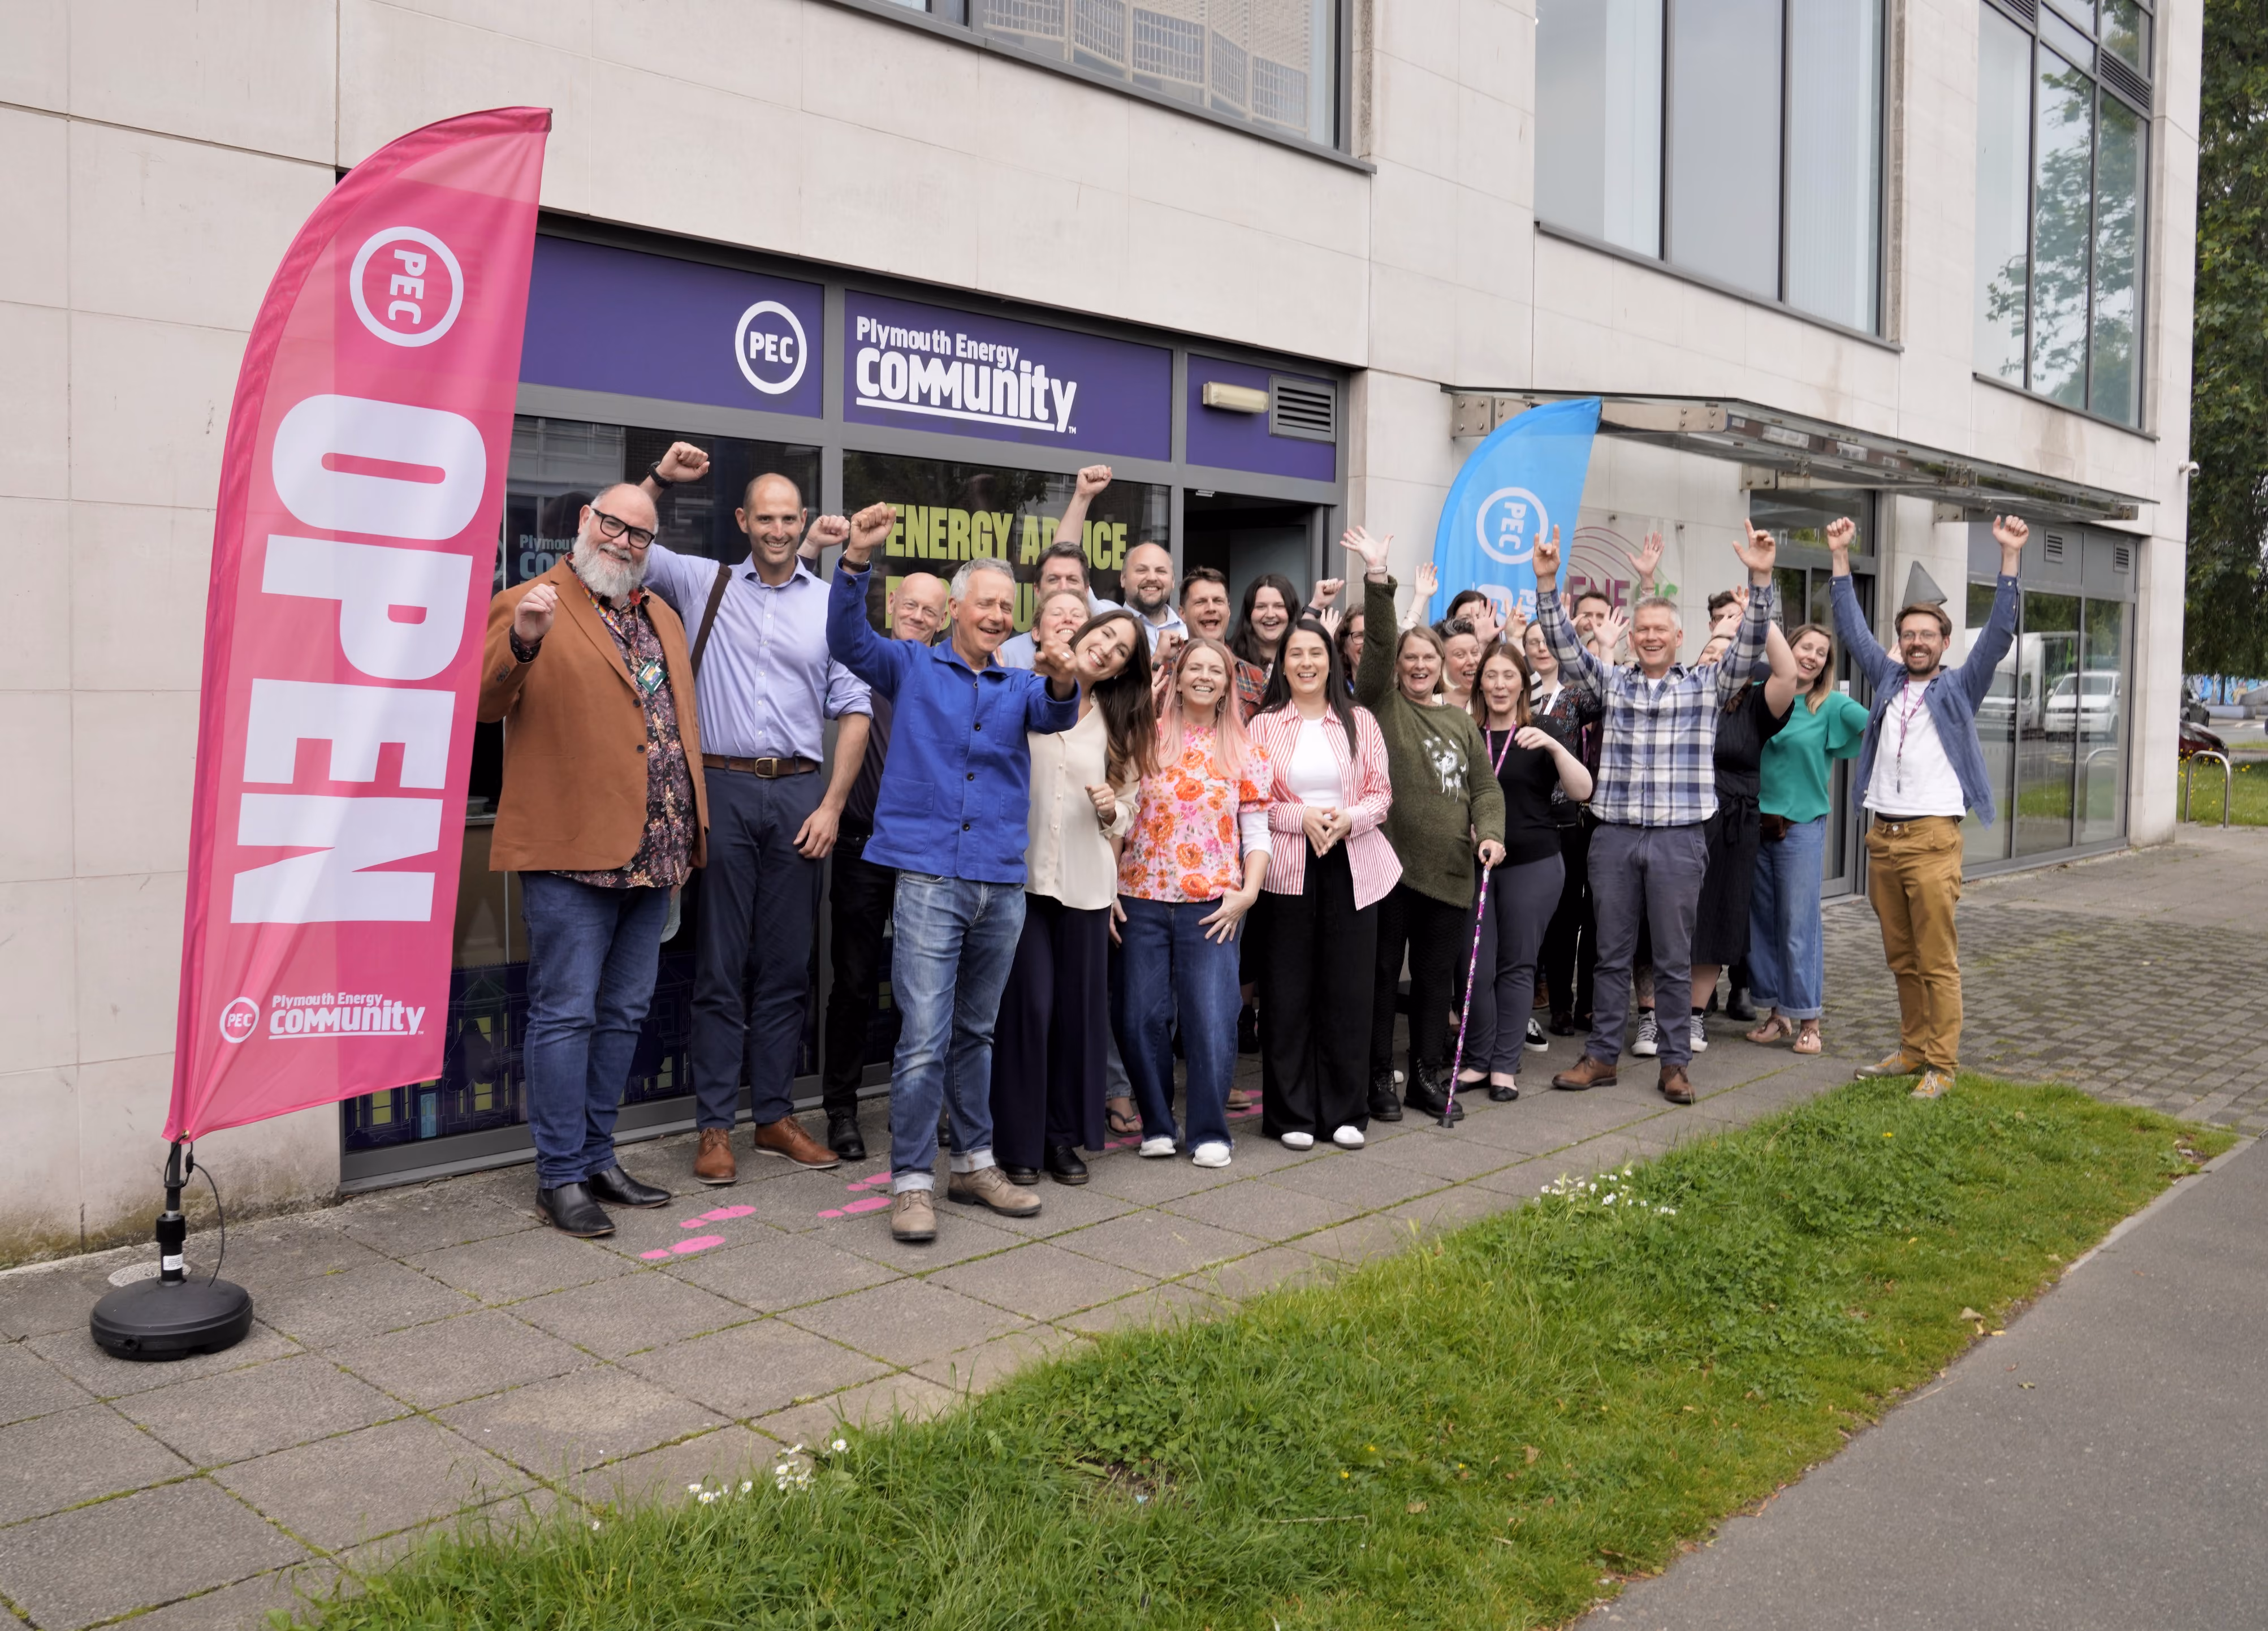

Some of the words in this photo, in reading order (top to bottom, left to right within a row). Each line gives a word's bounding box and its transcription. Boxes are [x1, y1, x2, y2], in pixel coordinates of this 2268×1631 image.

[388, 249, 427, 324] PEC
[750, 331, 794, 364] PEC
[857, 316, 951, 356] Plymouth
[956, 333, 1019, 370] Energy
[885, 503, 1014, 561] ENERGY
[1019, 515, 1127, 571] ADICE
[1498, 501, 1527, 550] PEC
[229, 393, 487, 925] OPEN
[227, 1013, 253, 1028] PEC
[272, 992, 335, 1009] Plymouth
[338, 992, 383, 1006] Energy
